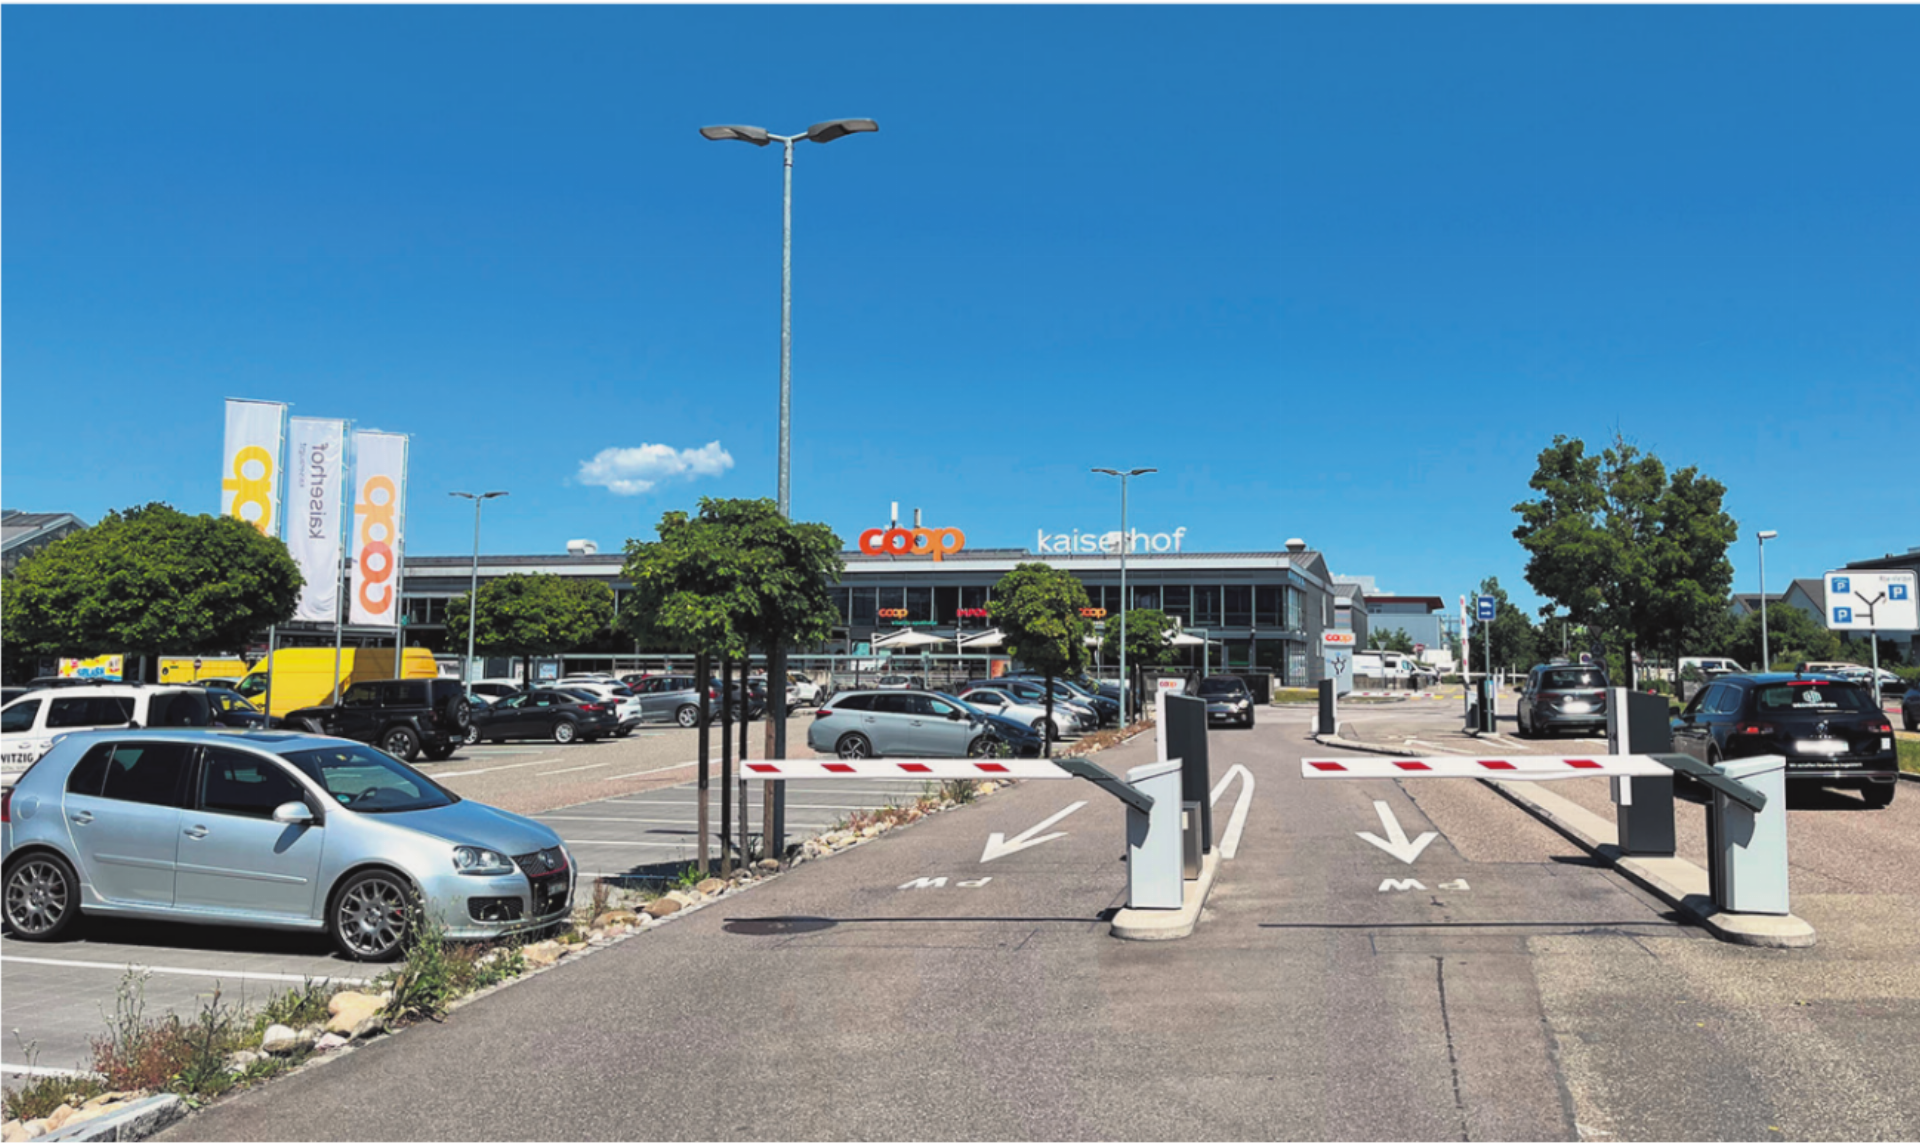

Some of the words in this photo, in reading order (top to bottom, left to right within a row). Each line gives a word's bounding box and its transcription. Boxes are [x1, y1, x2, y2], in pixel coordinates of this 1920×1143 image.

[859, 527, 965, 562] coop
[1037, 526, 1187, 553] kaisehof
[878, 608, 908, 619] coop
[1325, 633, 1353, 644] coop
